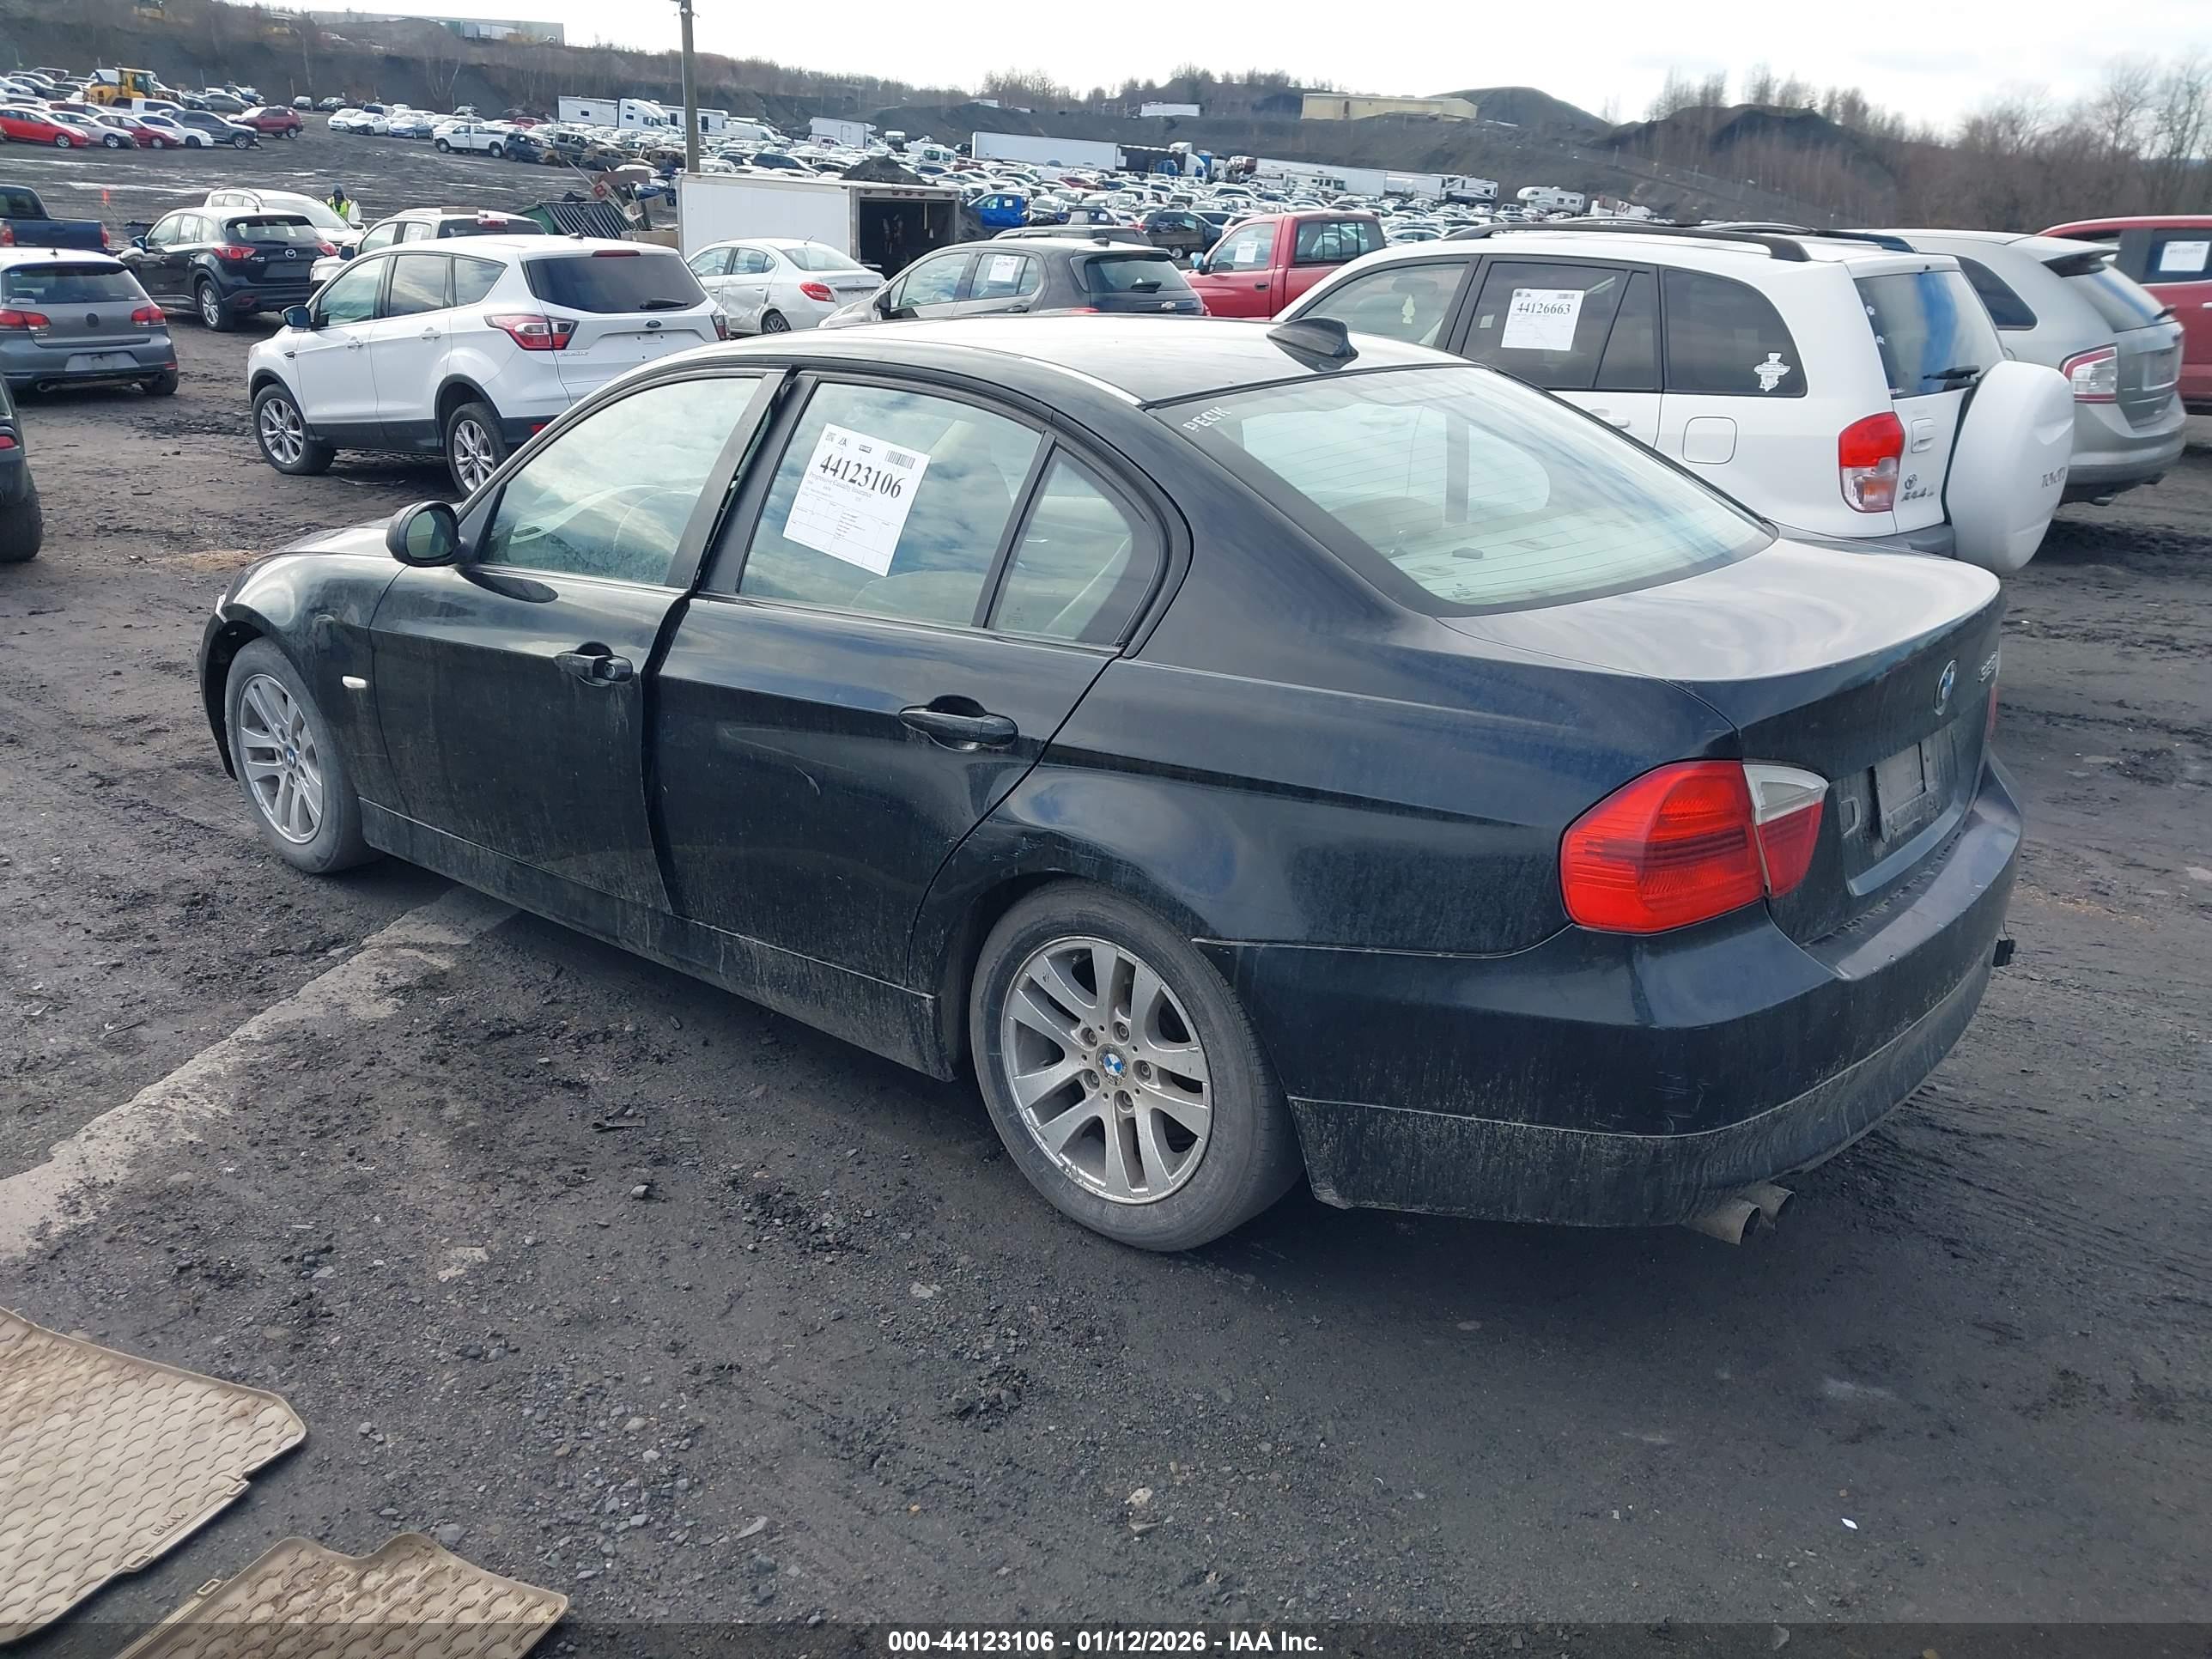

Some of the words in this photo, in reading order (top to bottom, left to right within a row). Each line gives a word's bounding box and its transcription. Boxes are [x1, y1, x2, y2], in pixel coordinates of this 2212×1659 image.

[1516, 302, 1571, 315] 44126663
[819, 453, 906, 499] 44123106
[150, 1510, 189, 1536] BMW
